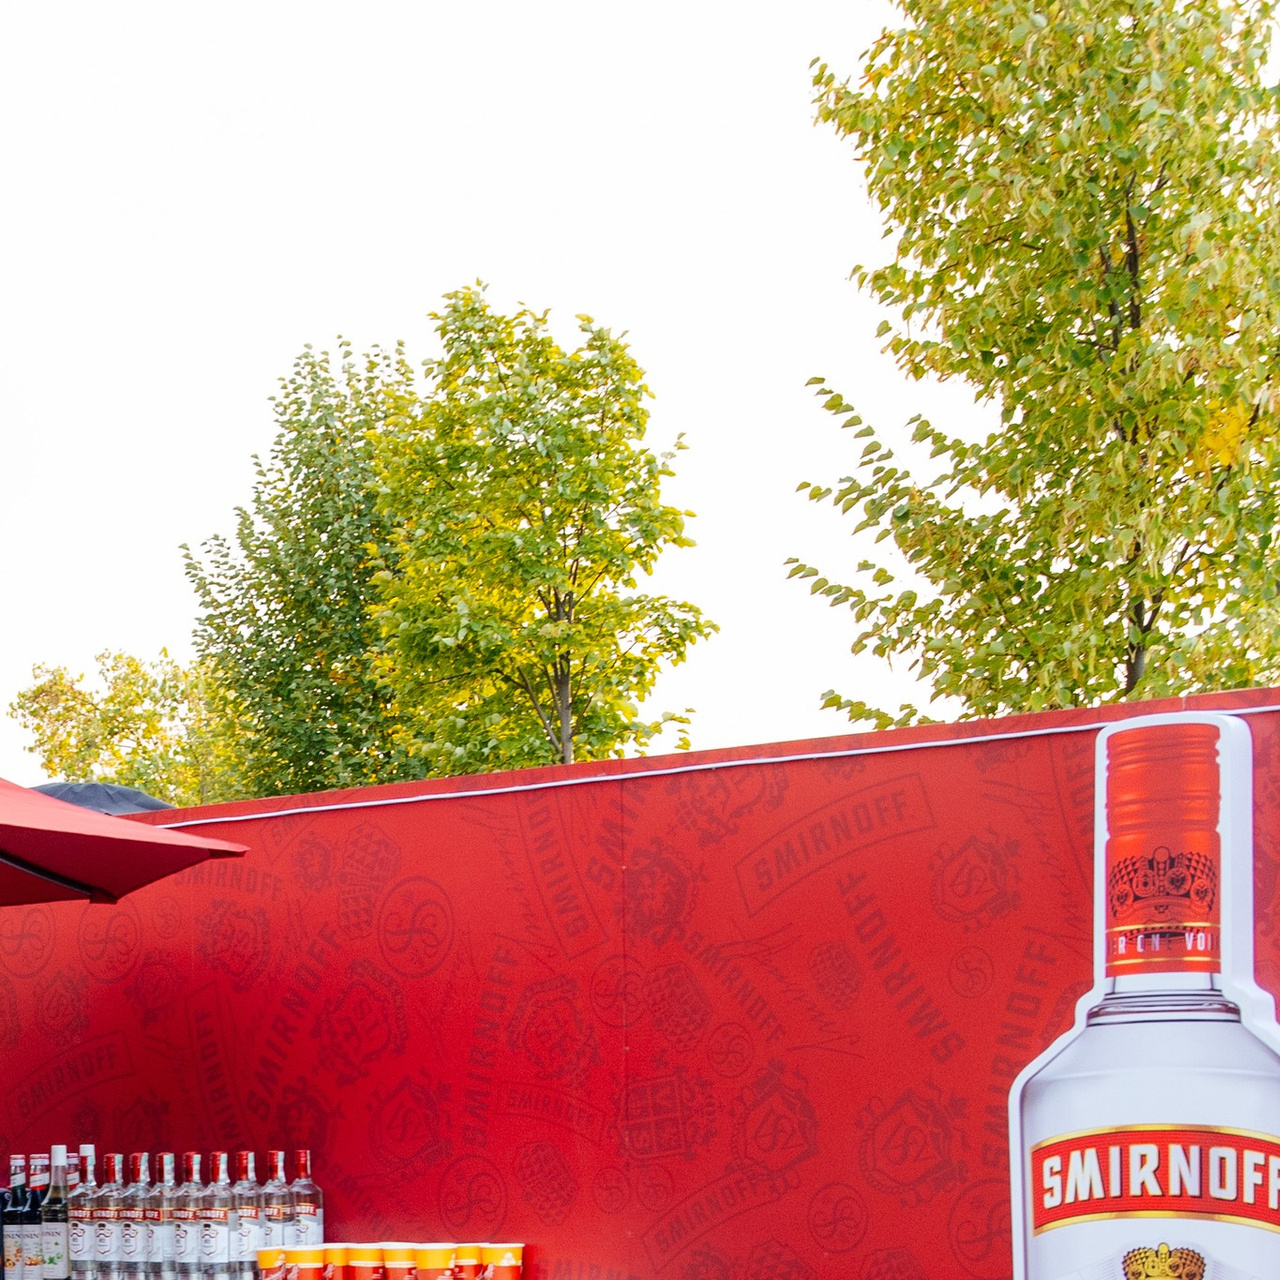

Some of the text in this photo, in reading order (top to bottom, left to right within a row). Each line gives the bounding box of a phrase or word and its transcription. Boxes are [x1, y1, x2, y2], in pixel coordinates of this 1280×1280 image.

[753, 788, 909, 893] SMIRNOFF
[246, 921, 343, 1123] SMIRNOFF
[461, 944, 519, 1149] SMIRNOFF
[835, 869, 967, 1066] SMIRNOFF
[980, 938, 1057, 1169] SMIRNOFF
[18, 1043, 117, 1119] SMIRNOFF
